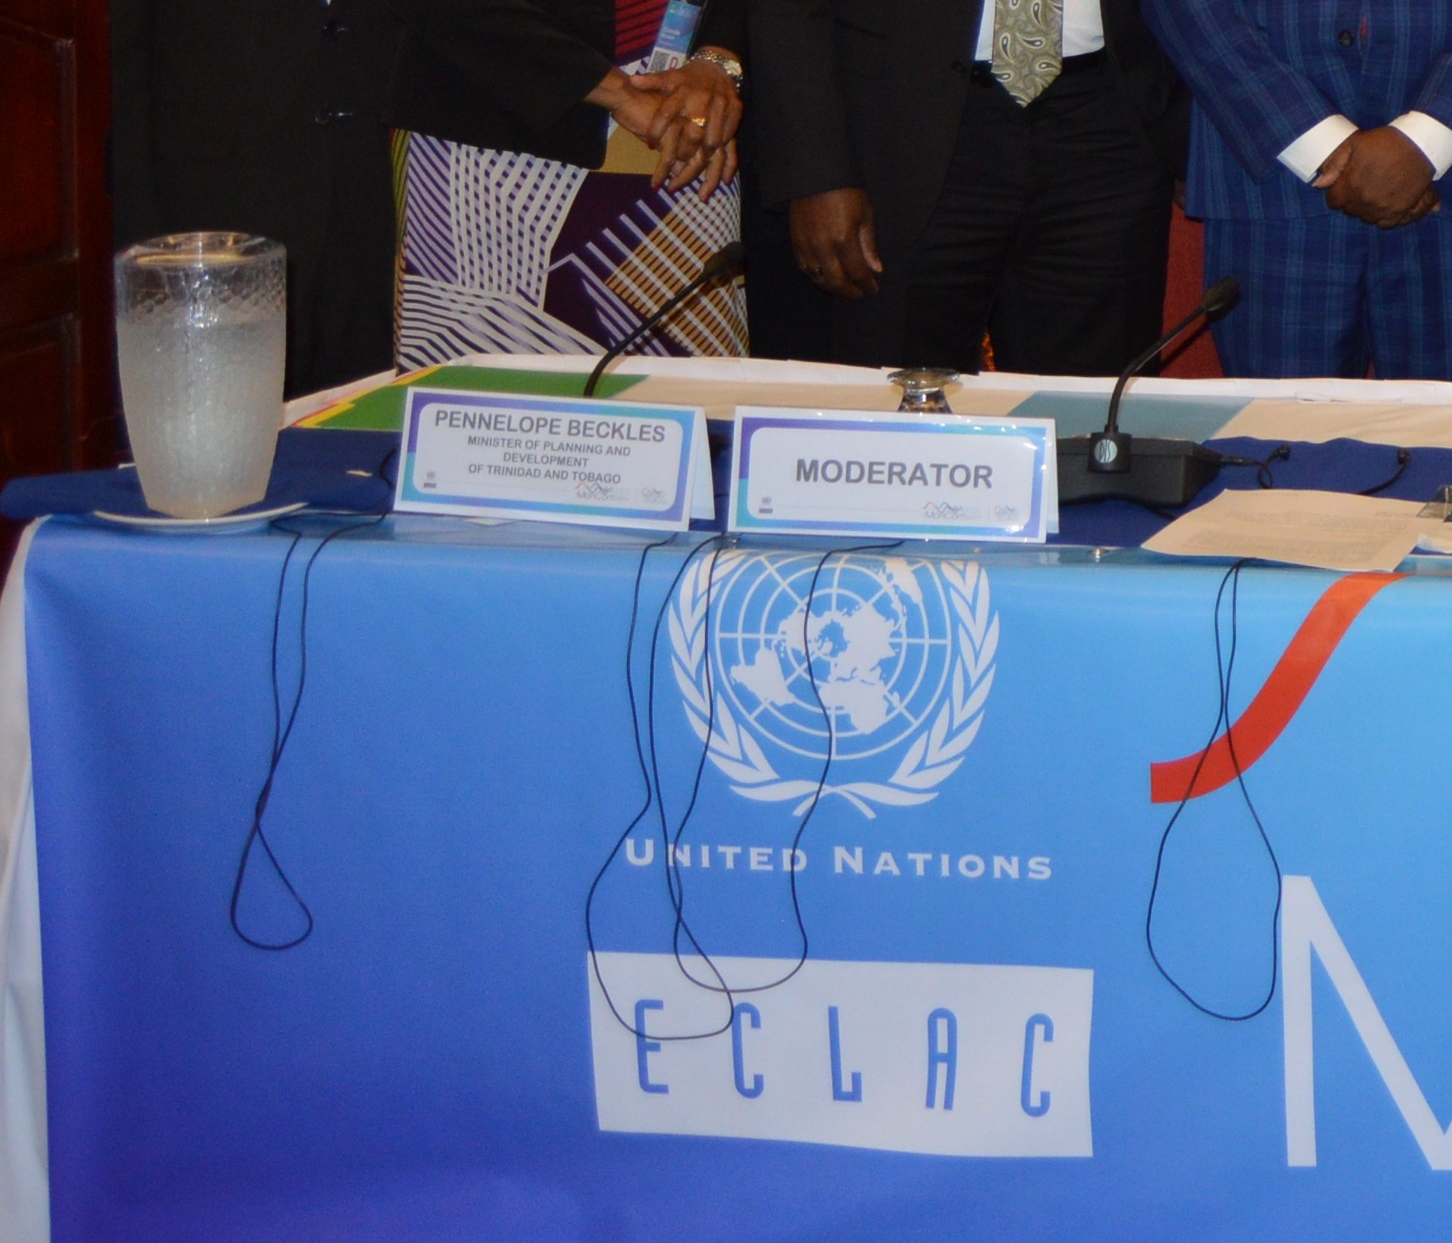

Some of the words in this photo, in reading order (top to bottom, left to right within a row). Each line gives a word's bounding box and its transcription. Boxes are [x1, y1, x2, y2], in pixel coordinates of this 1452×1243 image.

[435, 410, 562, 436] PENNELOPE
[567, 420, 666, 443] BECKLES
[468, 436, 522, 449] MINISTER
[525, 440, 541, 451] OF
[543, 441, 603, 455] PLANNING
[606, 445, 631, 456] AND
[503, 452, 589, 468] DEVELOPMENT
[468, 463, 485, 474] OF
[487, 464, 541, 479] TRINIDAD
[543, 468, 569, 481] AND
[571, 471, 621, 484] TOBAGO
[796, 458, 993, 489] MODERATOR
[625, 838, 808, 872] UNITED
[833, 846, 1053, 881] NATIONS
[634, 998, 1055, 1118] ECLAC
